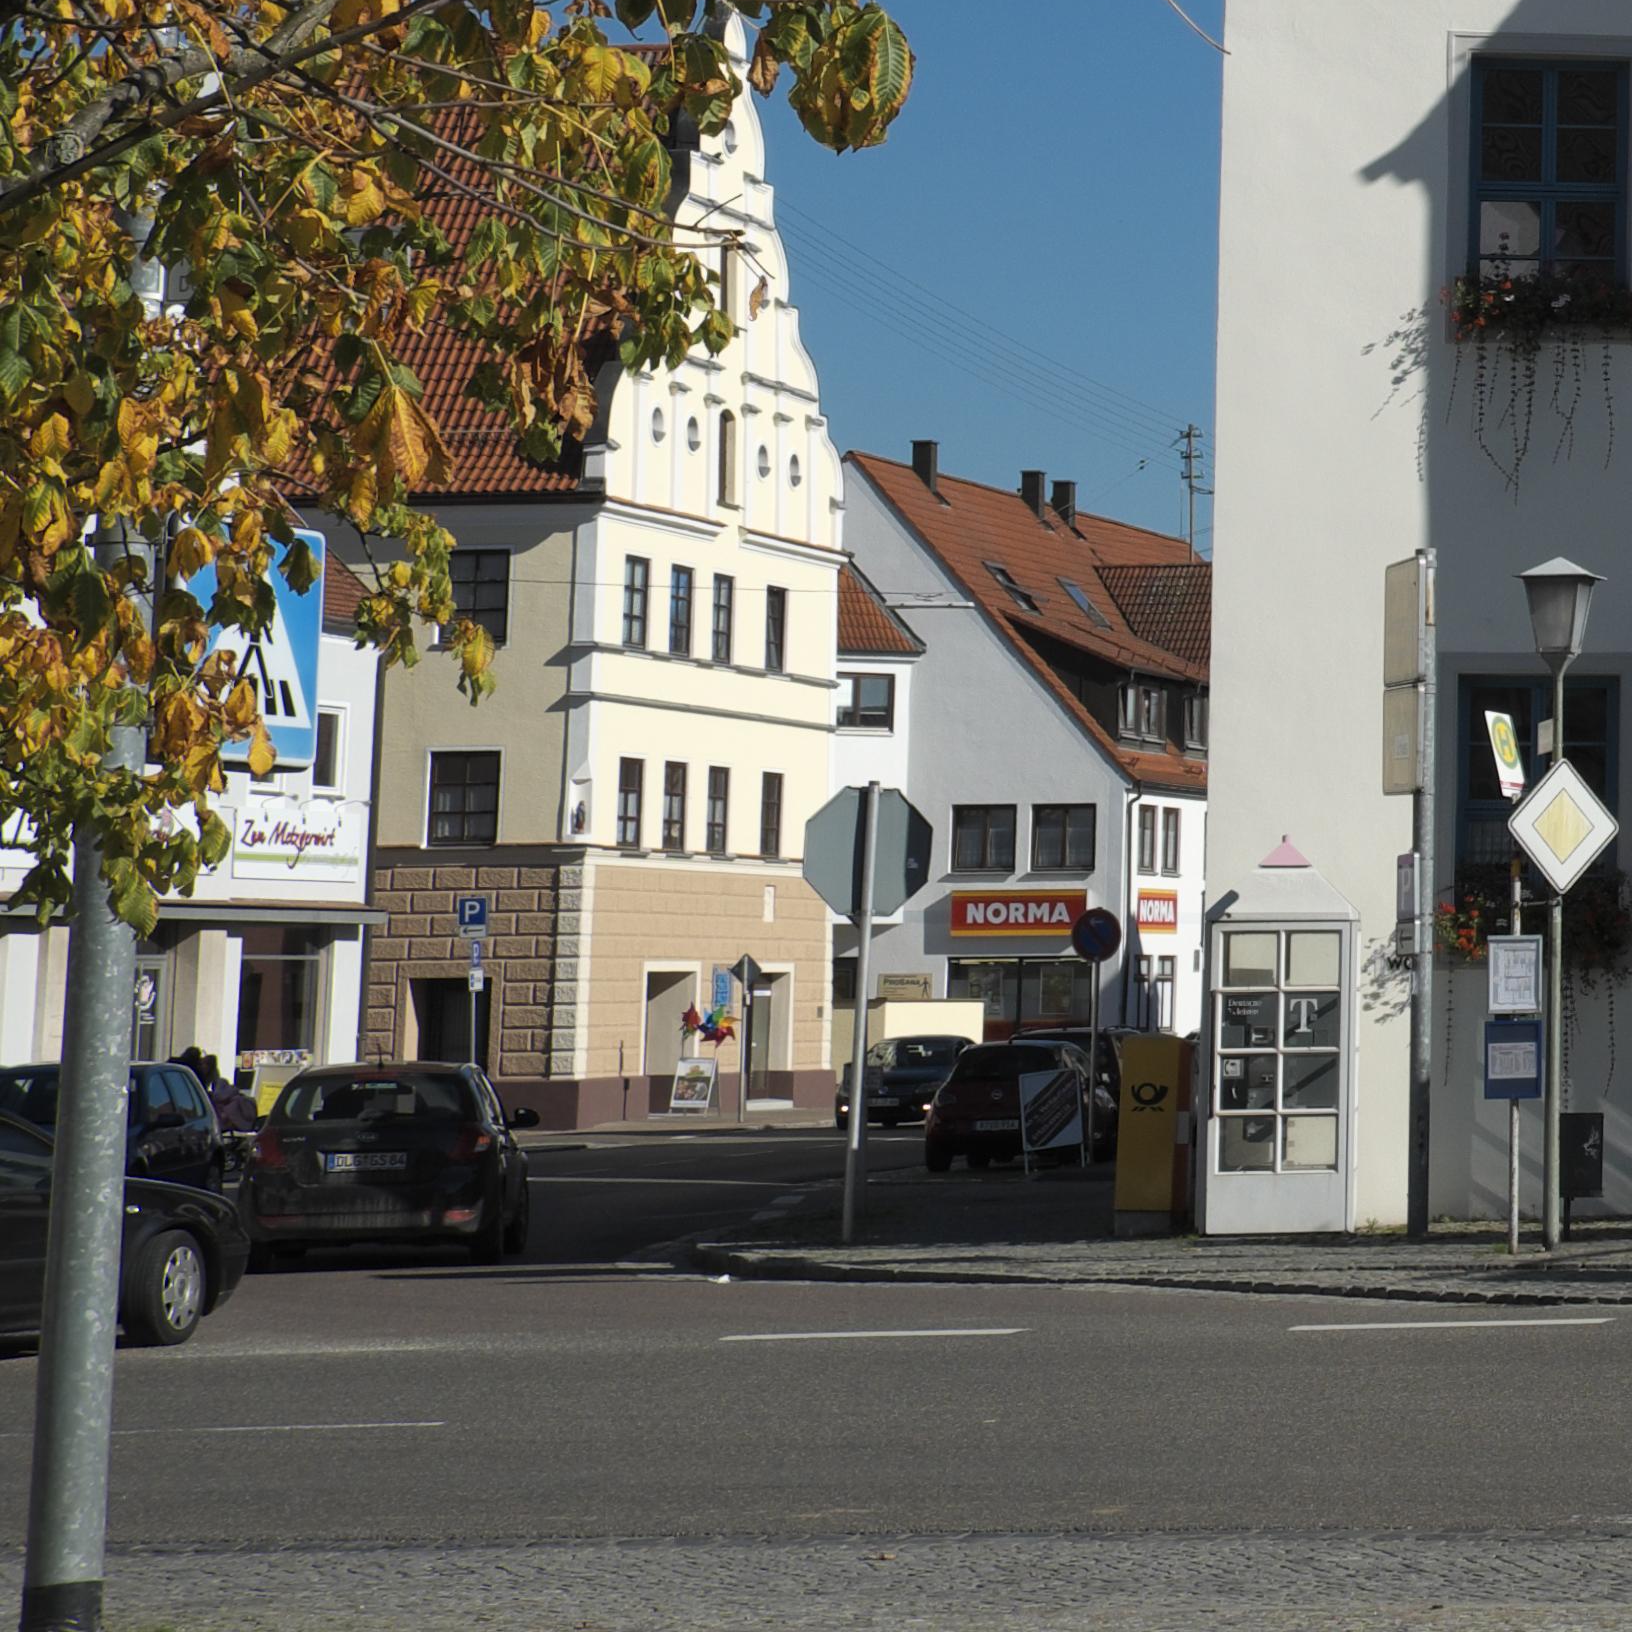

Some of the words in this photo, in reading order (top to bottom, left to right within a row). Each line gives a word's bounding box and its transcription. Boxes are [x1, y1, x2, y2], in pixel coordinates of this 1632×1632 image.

[1401, 869, 1412, 911] P
[465, 901, 480, 923] P
[966, 903, 1071, 924] NORMA
[1139, 899, 1175, 923] NORMA
[1290, 998, 1318, 1033] T
